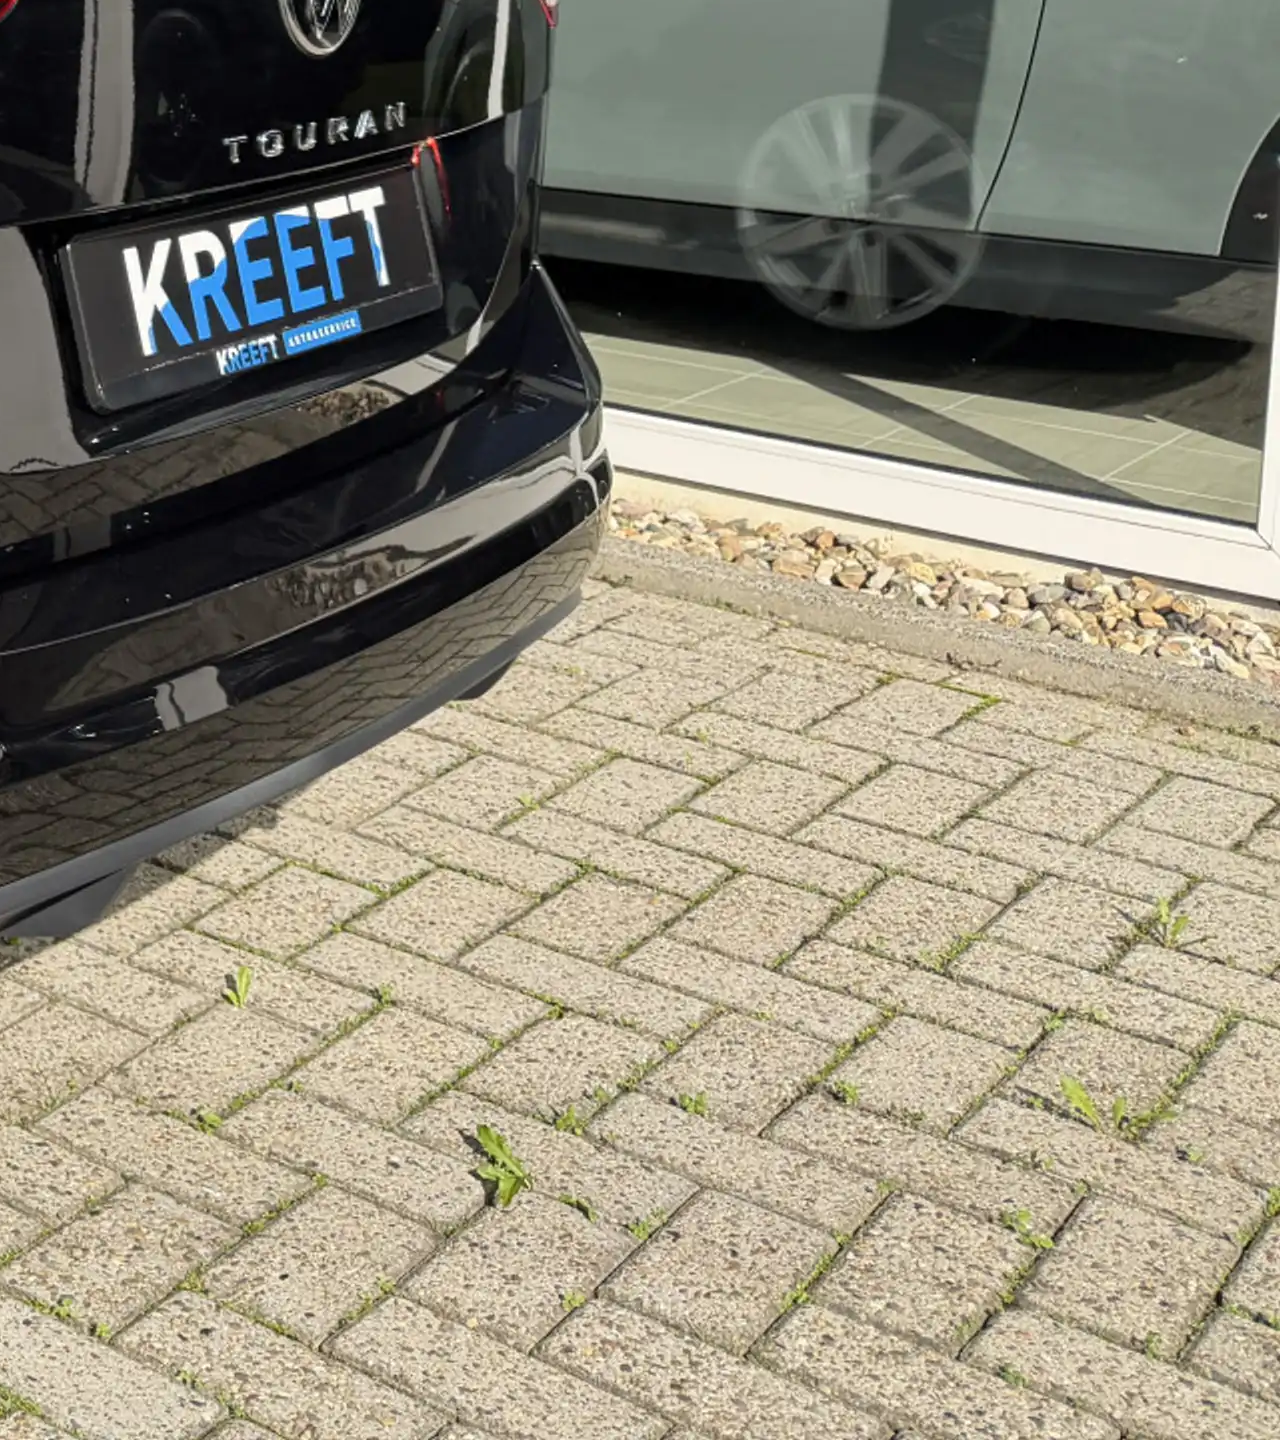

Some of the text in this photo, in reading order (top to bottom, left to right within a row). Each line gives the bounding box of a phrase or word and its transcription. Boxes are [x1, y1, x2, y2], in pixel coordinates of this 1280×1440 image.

[222, 100, 408, 164] TOURAN
[122, 186, 388, 357] KREEFT
[216, 333, 279, 376] KREEFT
